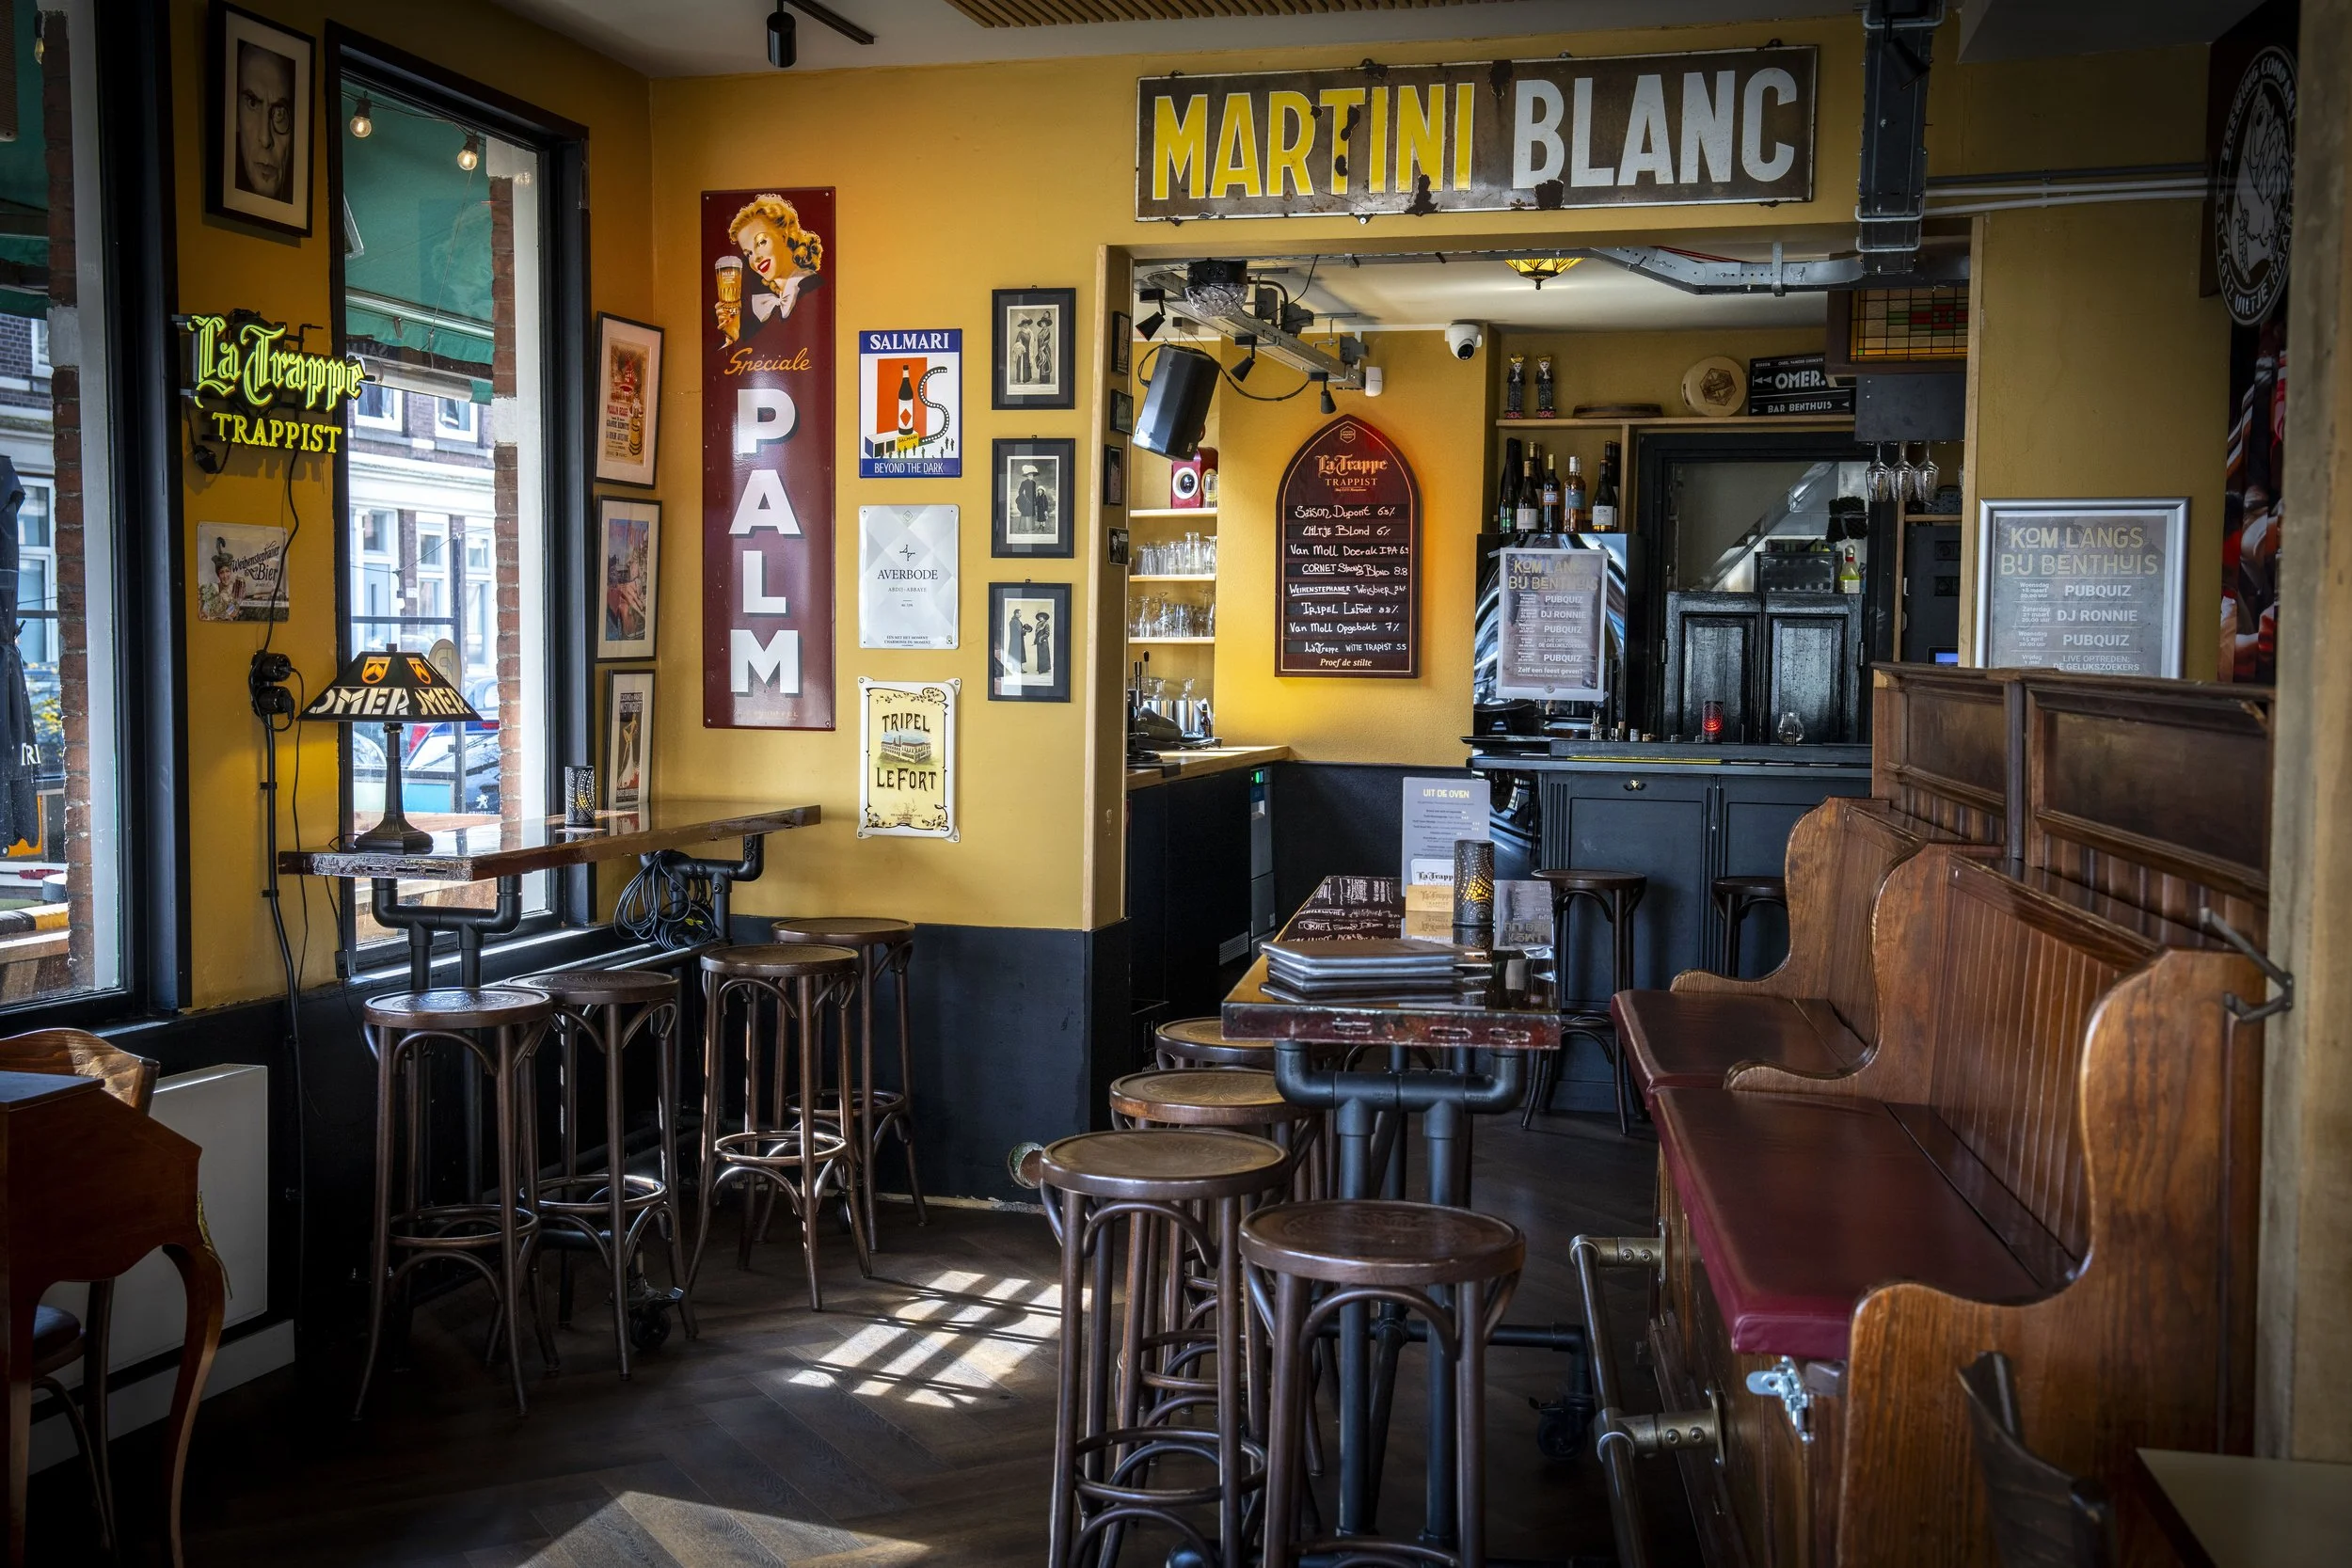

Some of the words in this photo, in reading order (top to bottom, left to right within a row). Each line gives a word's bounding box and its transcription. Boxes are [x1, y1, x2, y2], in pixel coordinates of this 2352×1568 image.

[1152, 83, 1474, 201] MARTINI
[1512, 67, 1798, 190] BLANC
[2233, 283, 2269, 316] UILTJE
[869, 332, 949, 350] SALMARI
[723, 347, 813, 376] Spéciale
[240, 324, 366, 413] Trappe
[1774, 370, 1827, 389] OMER.
[1768, 404, 1786, 414] BAR
[1788, 401, 1833, 412] BENTHUIS
[212, 411, 342, 454] TRAPPIST
[898, 435, 919, 444] SALMARI
[874, 462, 905, 474] BEYOND
[908, 462, 921, 474] THE
[923, 461, 945, 474] DARK
[1325, 478, 1378, 486] TRAPPIST
[1295, 505, 1332, 519] Saison
[1332, 504, 1371, 519] Dupont
[728, 388, 803, 695] PALM
[2010, 527, 2058, 549] KOM
[2065, 527, 2144, 549] LANGS
[1290, 544, 1310, 555] Van
[1343, 546, 1378, 556] Doerak
[1379, 546, 1398, 555] IPA
[249, 562, 278, 581] Bier
[1301, 563, 1337, 575] CORNET
[1514, 560, 1542, 574] KOM
[2041, 554, 2158, 576] BENTHUIS
[877, 569, 939, 580] AVERBODE
[2064, 585, 2132, 598] PUBQUIZ
[1545, 594, 1583, 604] PUBQUIZ
[1540, 610, 1552, 618] DJ
[1553, 610, 1587, 619] RONNIE
[2057, 610, 2075, 622] DJ
[2079, 610, 2138, 622] RONNIE
[1290, 622, 1308, 633] Van
[1337, 622, 1377, 635] Opgebokt
[1385, 623, 1400, 632] 7%
[1544, 625, 1582, 634] PUBQUIZ
[2062, 634, 2130, 647] PUBQUIZ
[1320, 658, 1342, 668] Proef
[1353, 658, 1373, 667] stilte
[1543, 653, 1582, 662] PUBQUIZ
[2062, 655, 2081, 663] LIVE
[2082, 655, 2130, 663] OPTREDEN:
[2065, 663, 2140, 672] GELUKSZOEKERS
[882, 712, 930, 733] TRIPEL
[1422, 789, 1435, 798] UIT
[1449, 790, 1470, 799] OVEN
[1428, 871, 1454, 882] Trapp
